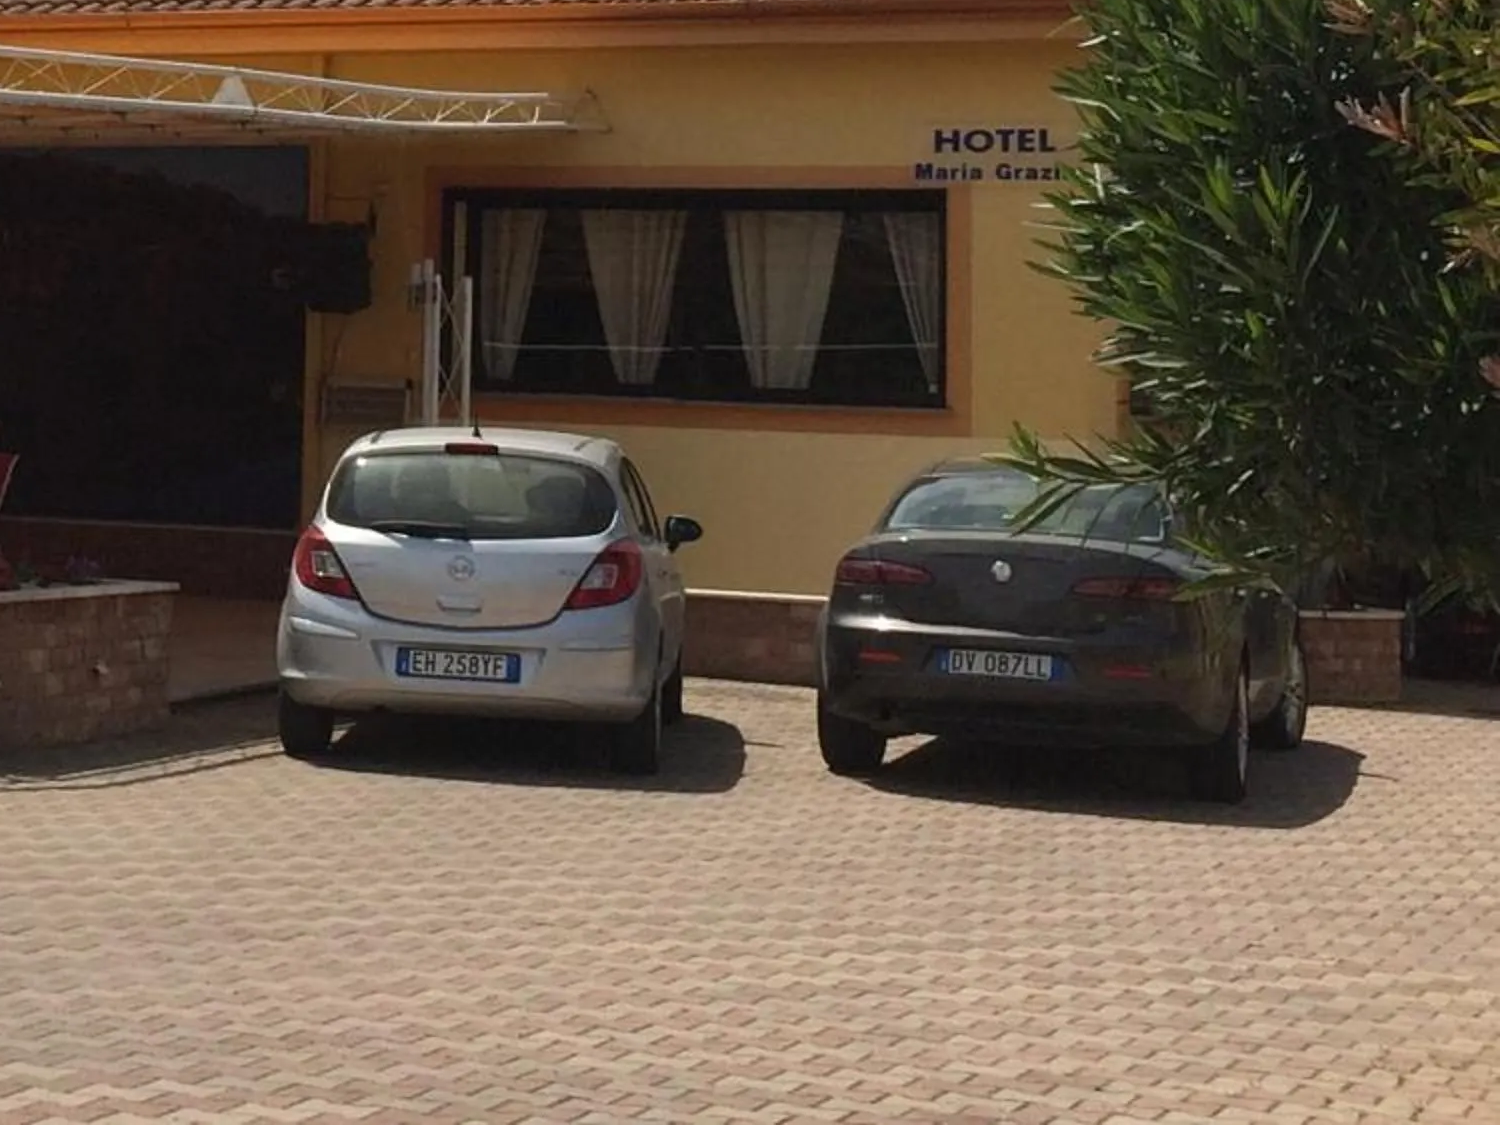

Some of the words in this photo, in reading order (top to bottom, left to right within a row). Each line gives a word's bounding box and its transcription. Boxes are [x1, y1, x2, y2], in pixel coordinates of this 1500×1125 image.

[933, 129, 1057, 153] HOTEL
[915, 163, 982, 180] Maria
[995, 163, 1062, 180] Grazi
[412, 651, 437, 672] EH
[951, 651, 976, 671] DV
